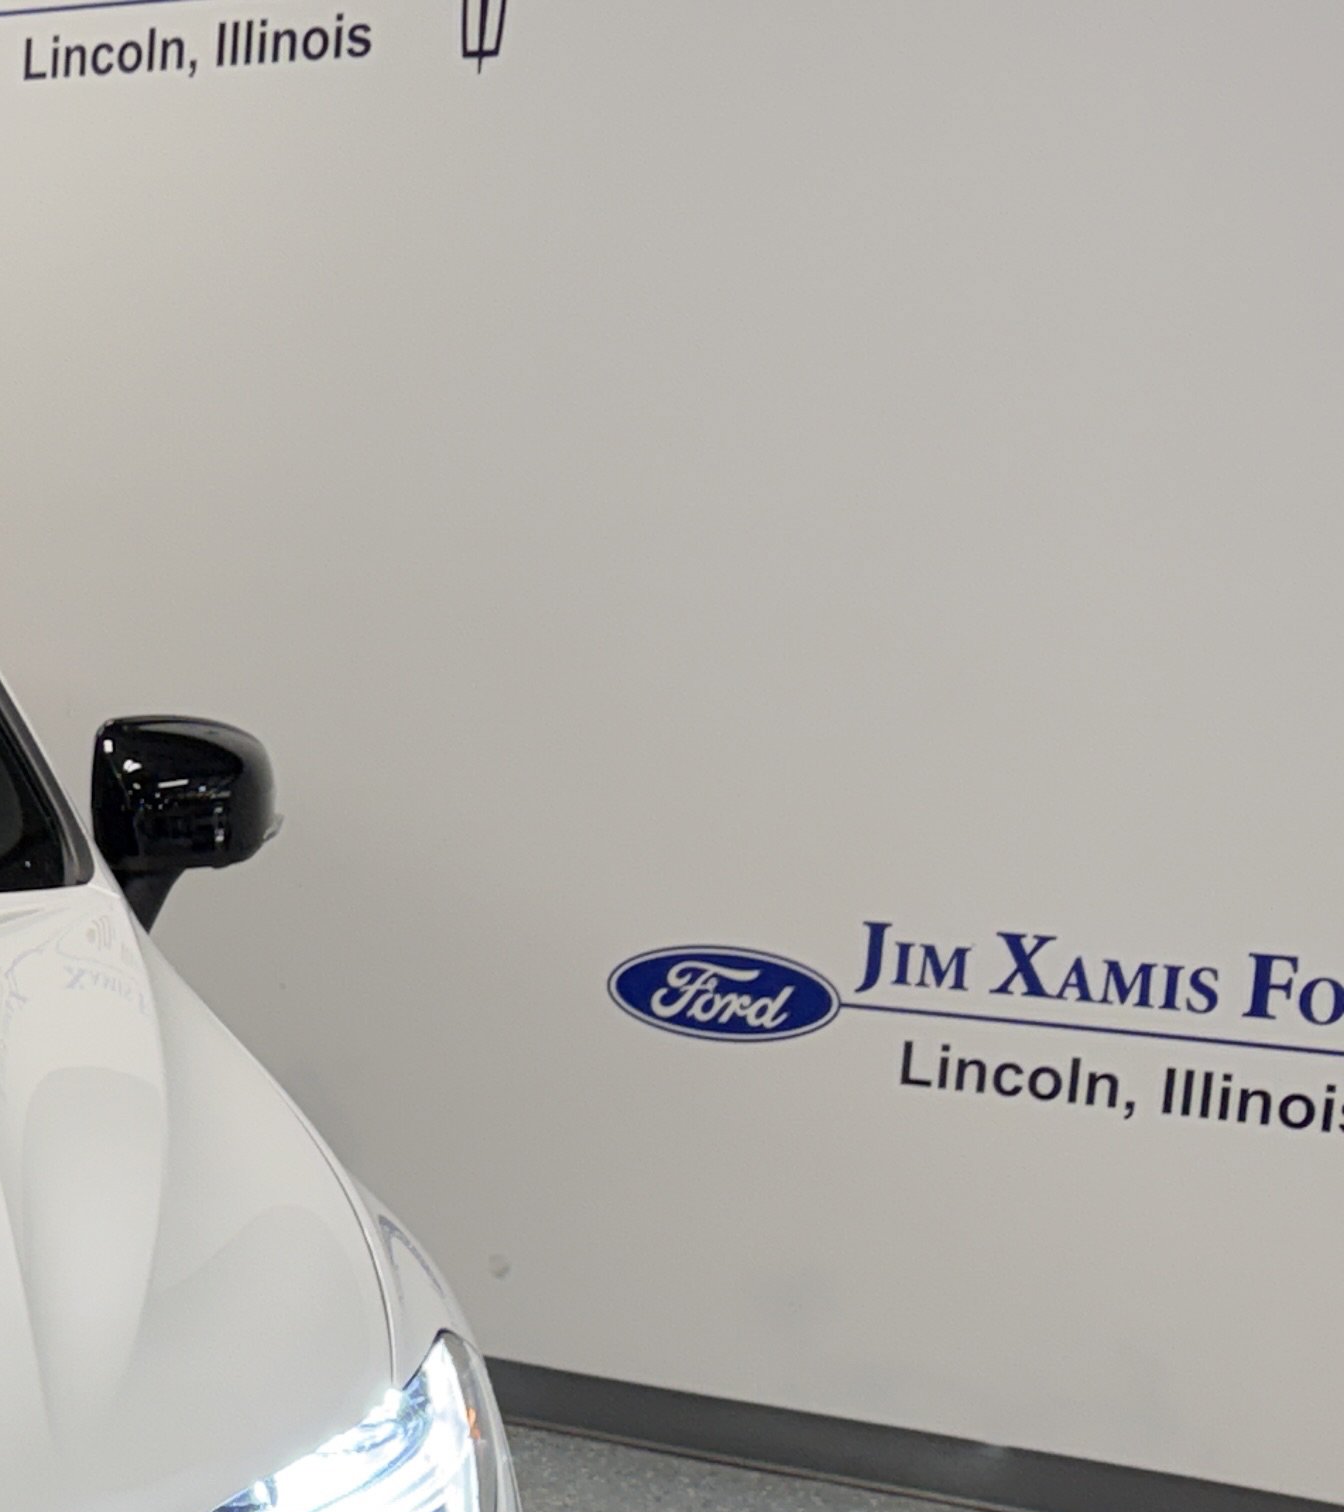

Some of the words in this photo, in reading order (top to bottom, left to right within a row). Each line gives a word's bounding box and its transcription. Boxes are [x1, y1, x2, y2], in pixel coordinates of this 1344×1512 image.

[23, 26, 199, 80] Lincoln,
[216, 13, 373, 67] Illinois
[650, 960, 796, 1029] Ford
[899, 1040, 1137, 1120] Lincoln,
[1162, 1067, 1344, 1134] Illinoi
